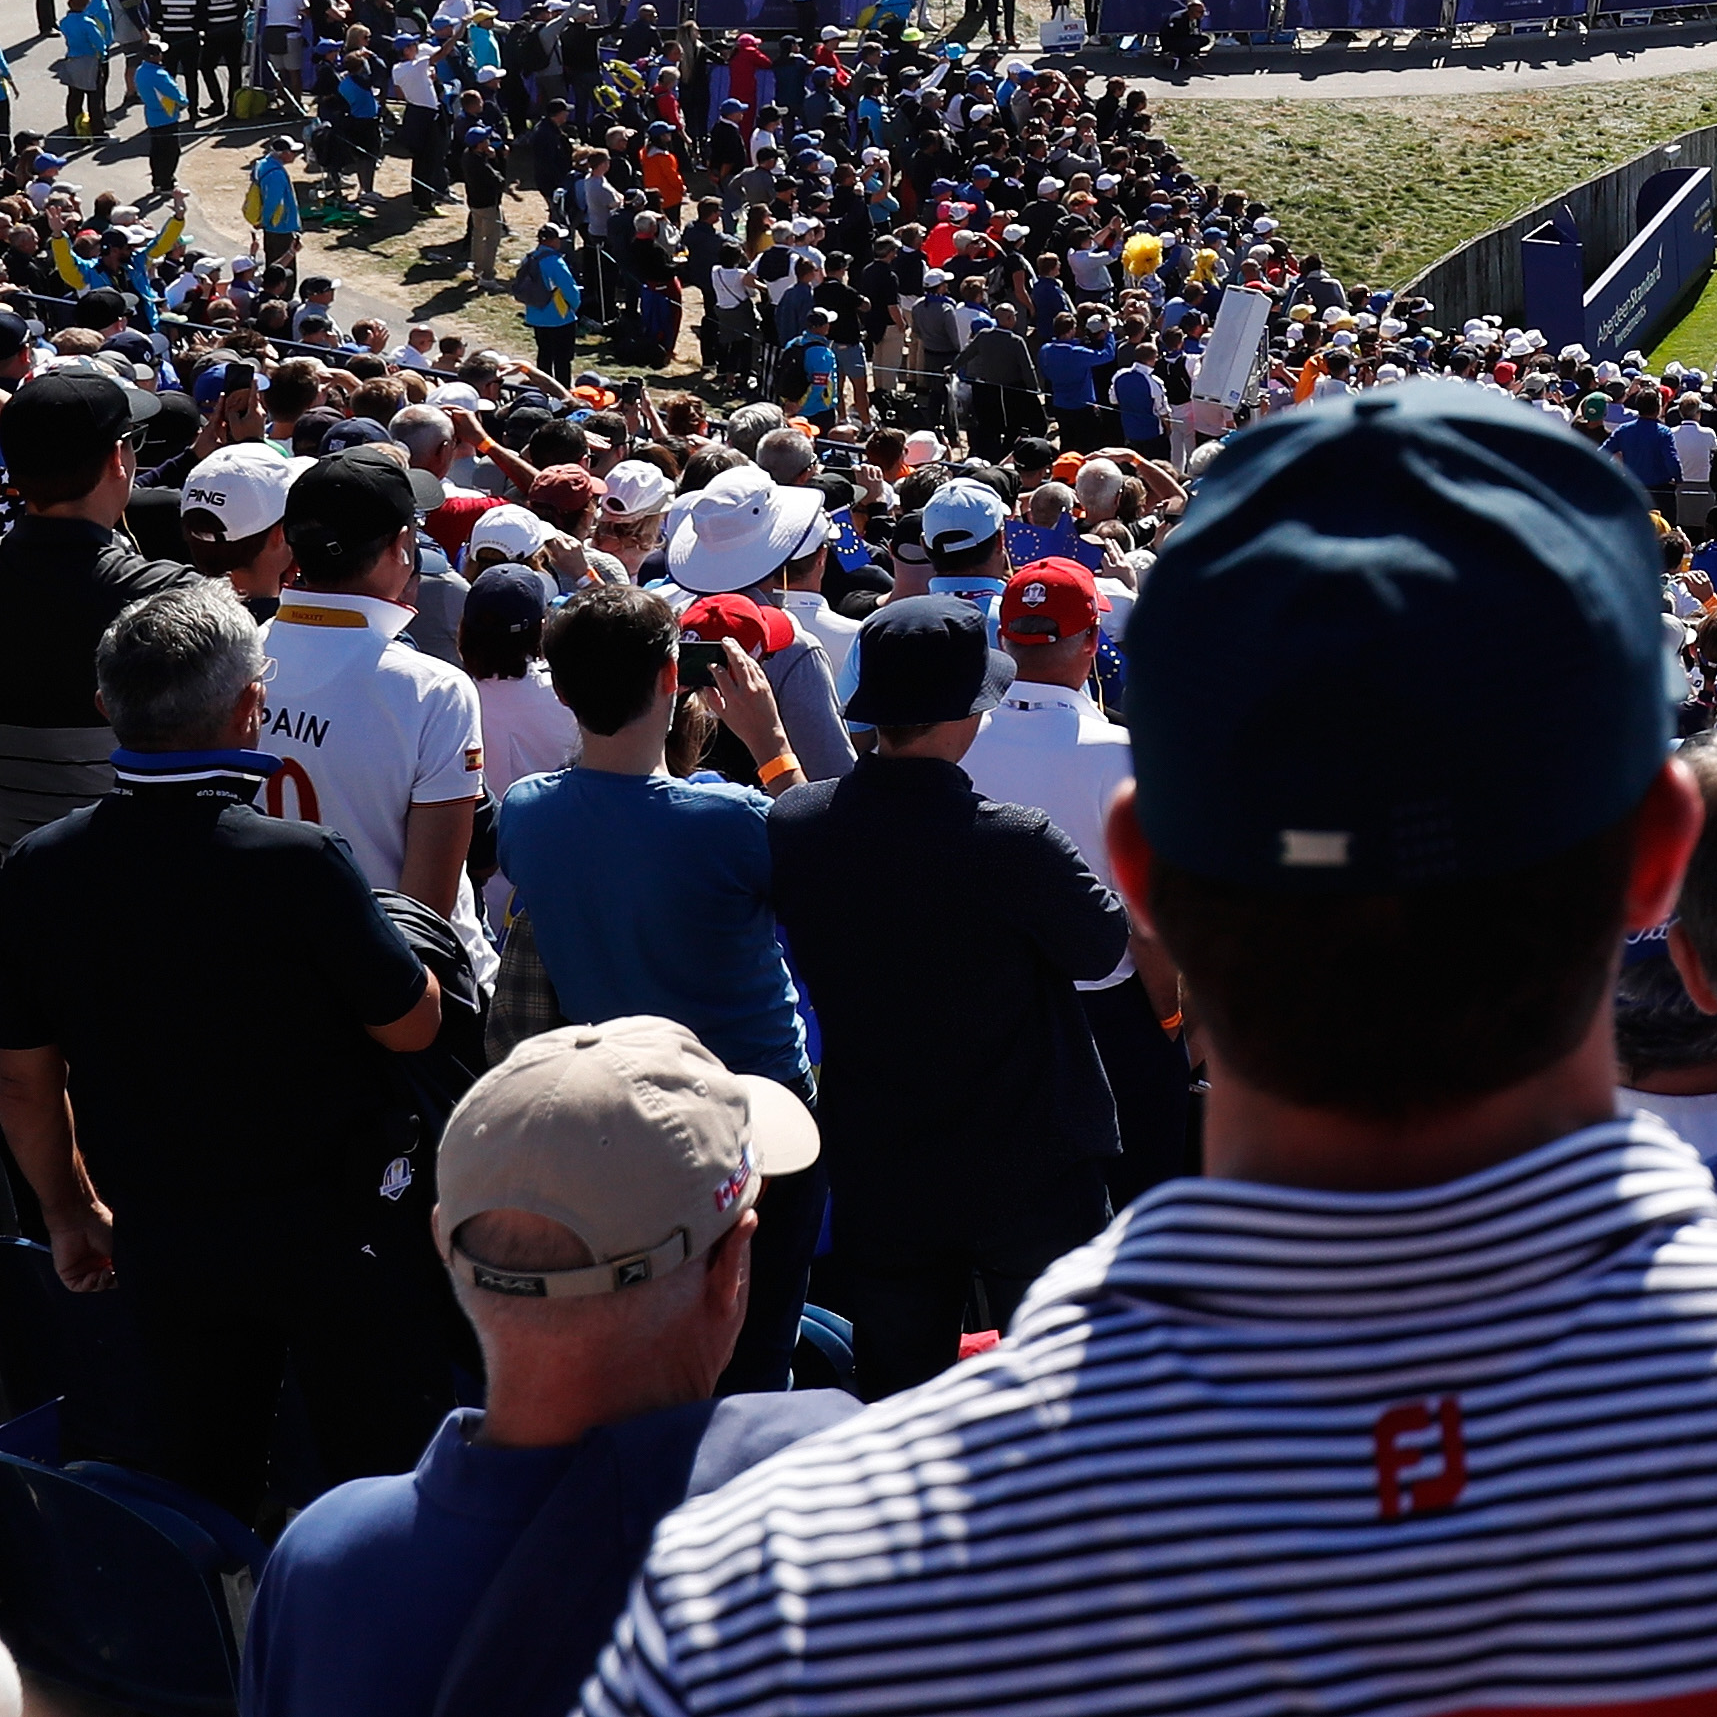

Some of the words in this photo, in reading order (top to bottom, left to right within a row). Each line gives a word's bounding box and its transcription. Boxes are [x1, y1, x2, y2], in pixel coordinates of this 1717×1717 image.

[1597, 297, 1632, 348] Aberdeen
[1629, 262, 1663, 307] Standard
[186, 489, 227, 507] PING
